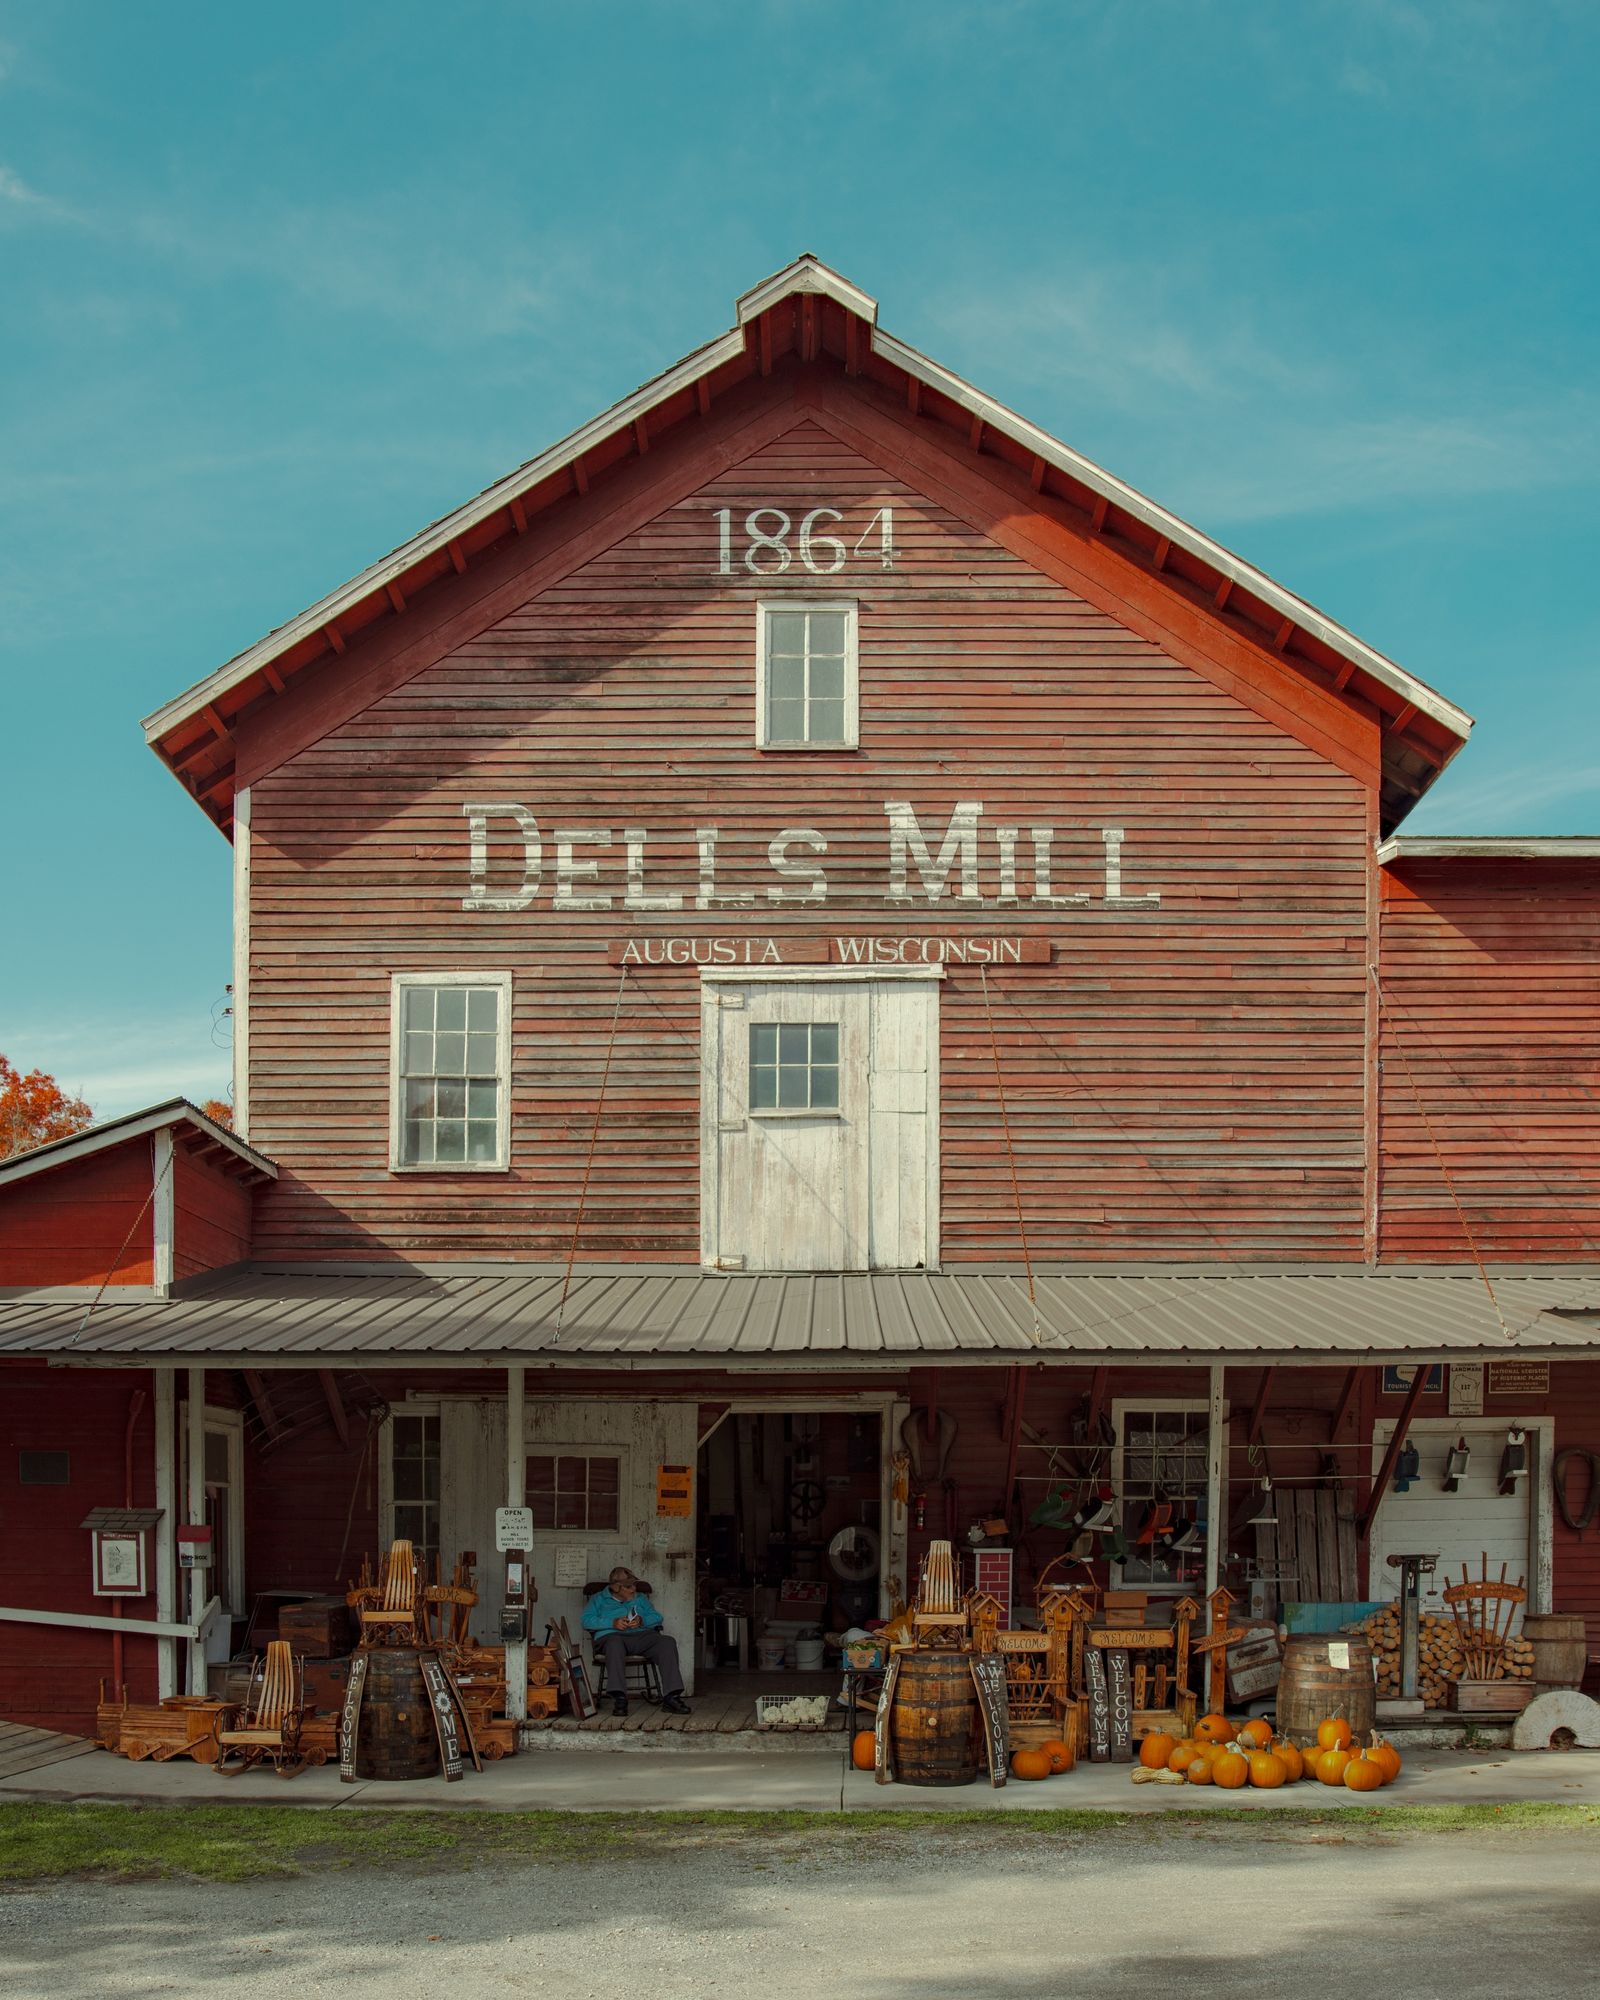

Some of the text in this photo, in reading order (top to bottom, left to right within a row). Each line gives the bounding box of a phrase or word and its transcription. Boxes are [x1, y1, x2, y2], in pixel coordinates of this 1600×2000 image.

[712, 507, 901, 576] 1864
[461, 799, 1161, 911] DELLS MILL
[620, 936, 1024, 965] AUGUSTA WISCONSIN
[998, 1637, 1047, 1649] WELCOME
[1099, 1631, 1155, 1645] WELCOME
[341, 1659, 364, 1762] WELCOME
[976, 1665, 1005, 1768] WELCOME
[1110, 1659, 1129, 1746] WELCOME
